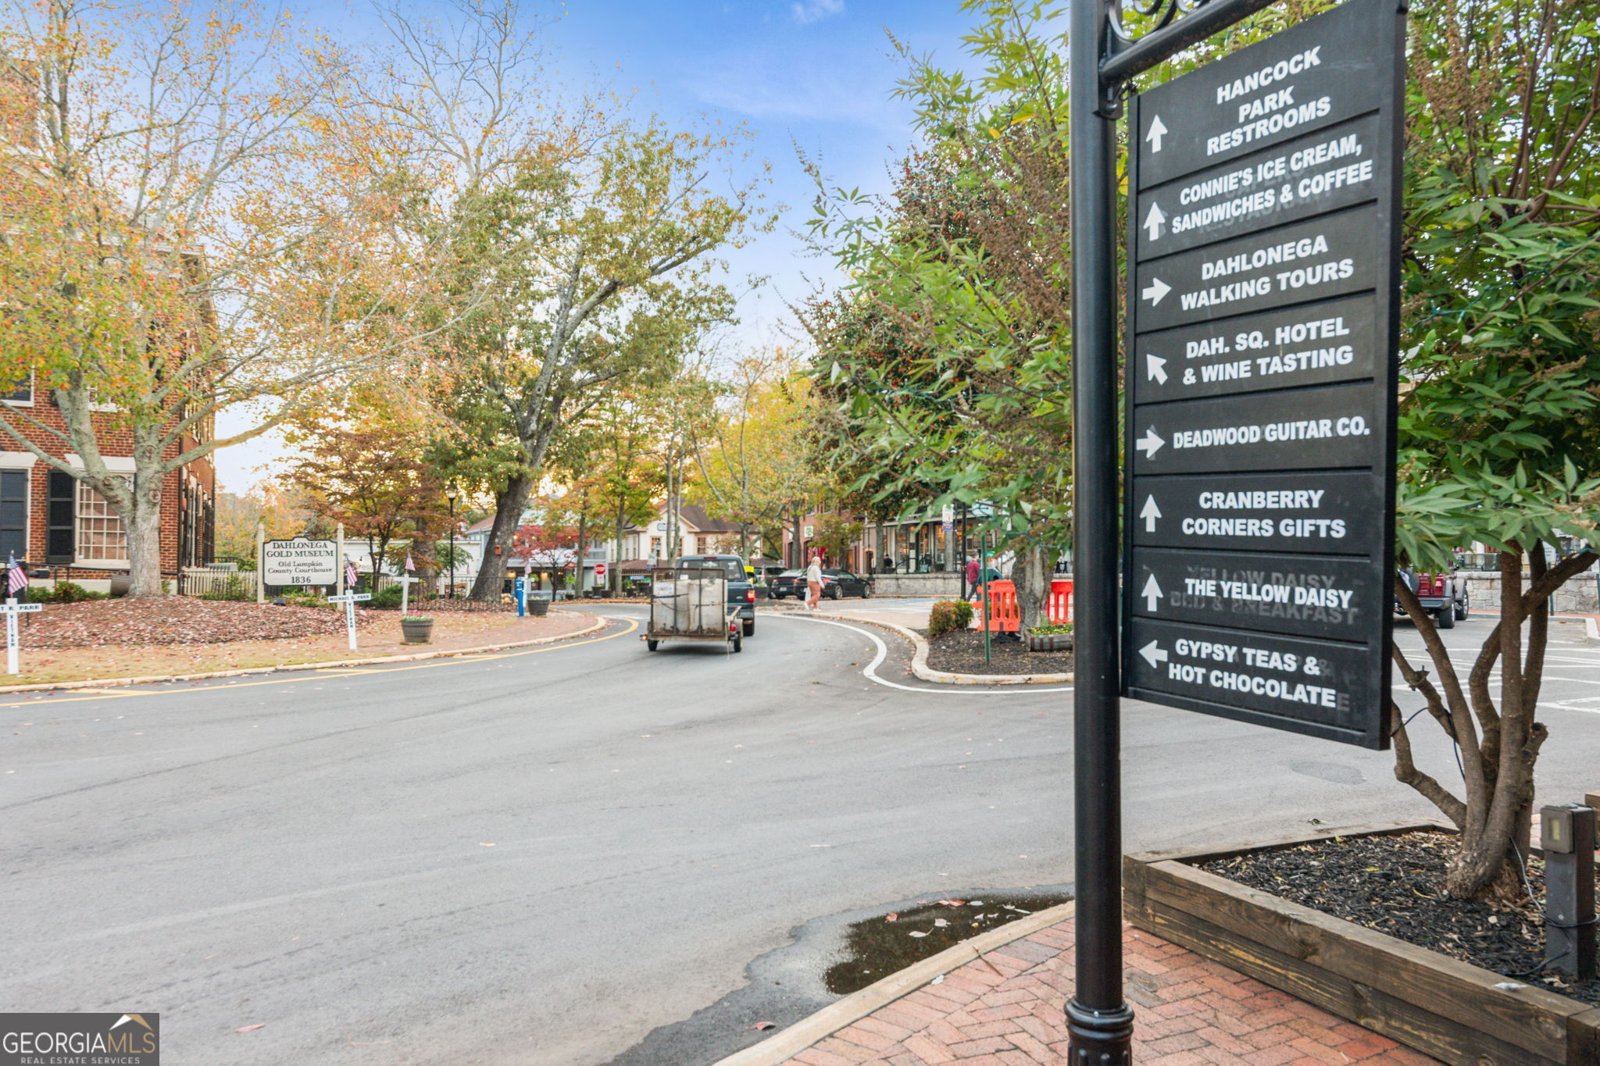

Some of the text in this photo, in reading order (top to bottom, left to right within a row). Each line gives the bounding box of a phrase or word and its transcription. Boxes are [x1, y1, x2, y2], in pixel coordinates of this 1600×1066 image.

[1216, 45, 1322, 104] HANCOCK
[1238, 86, 1295, 123] PARK
[1206, 96, 1331, 156] RESTROOMS
[1180, 167, 1253, 205] CONNIE'S
[1257, 157, 1286, 183] ICE
[1289, 134, 1362, 171] CREAM,
[1171, 191, 1275, 234] SANDWICHES
[1280, 184, 1293, 203] &
[1298, 160, 1373, 198] COFFEE
[1201, 234, 1329, 281] DAHLONEGA
[1180, 258, 1354, 311] WALKING TOURS
[1186, 316, 1350, 359] DAH. SQ. HOTEL
[1182, 345, 1354, 385] & WINE TASTING
[1173, 416, 1371, 449] DEADWOOD GUITAR CO.
[1199, 490, 1325, 509] CRANBERRY
[1181, 518, 1346, 539] CORNERS GIFTS
[266, 550, 292, 558] GOLD
[1184, 577, 1354, 609] THE YELLOW DAISY
[1175, 638, 1238, 663] GYPSY
[1242, 647, 1297, 673] TEAS
[1303, 656, 1320, 676] &
[1168, 662, 1207, 685] HOT
[1209, 670, 1337, 708] CHOCOLATE
